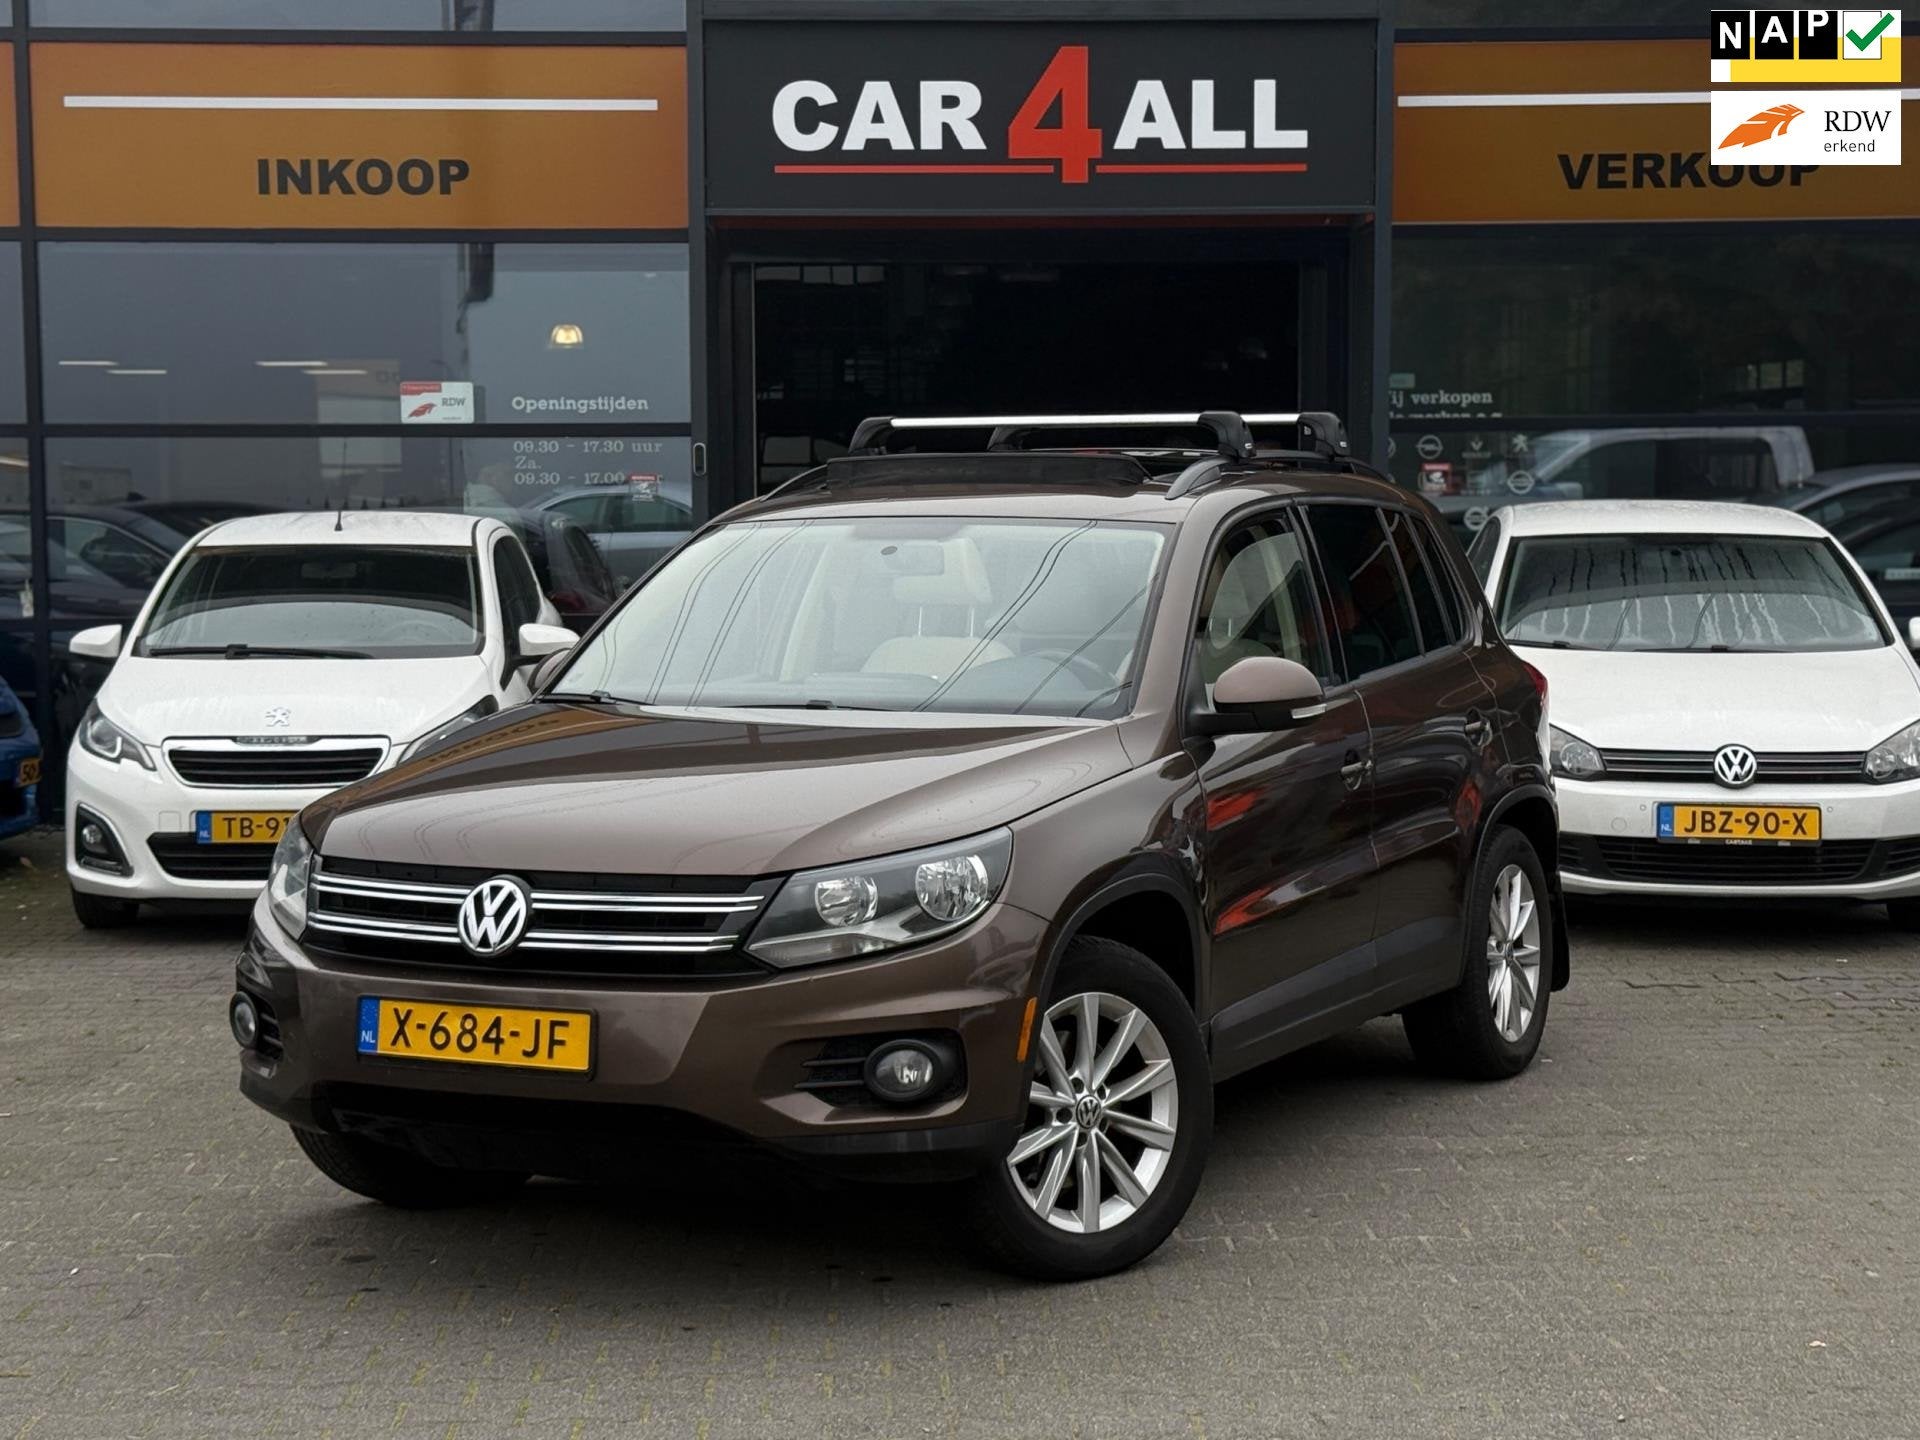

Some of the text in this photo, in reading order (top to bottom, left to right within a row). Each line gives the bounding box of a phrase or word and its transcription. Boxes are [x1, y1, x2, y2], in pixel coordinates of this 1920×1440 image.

[772, 46, 1308, 183] CAR 4 ALL
[257, 158, 470, 196] INKOOP
[441, 397, 466, 407] RDW
[511, 396, 649, 413] Openingstijden
[1411, 390, 1493, 407] verkopen
[513, 440, 559, 453] 09.30
[583, 440, 624, 453] 17.30
[631, 442, 663, 453] uur
[514, 455, 542, 470] Za.
[514, 472, 560, 485] 09.30
[584, 472, 625, 485] 17.00
[1660, 824, 1673, 832] NL
[1683, 810, 1808, 836] JBZ-90-X
[361, 1030, 376, 1044] NL
[390, 1007, 570, 1060] X-684-JF
